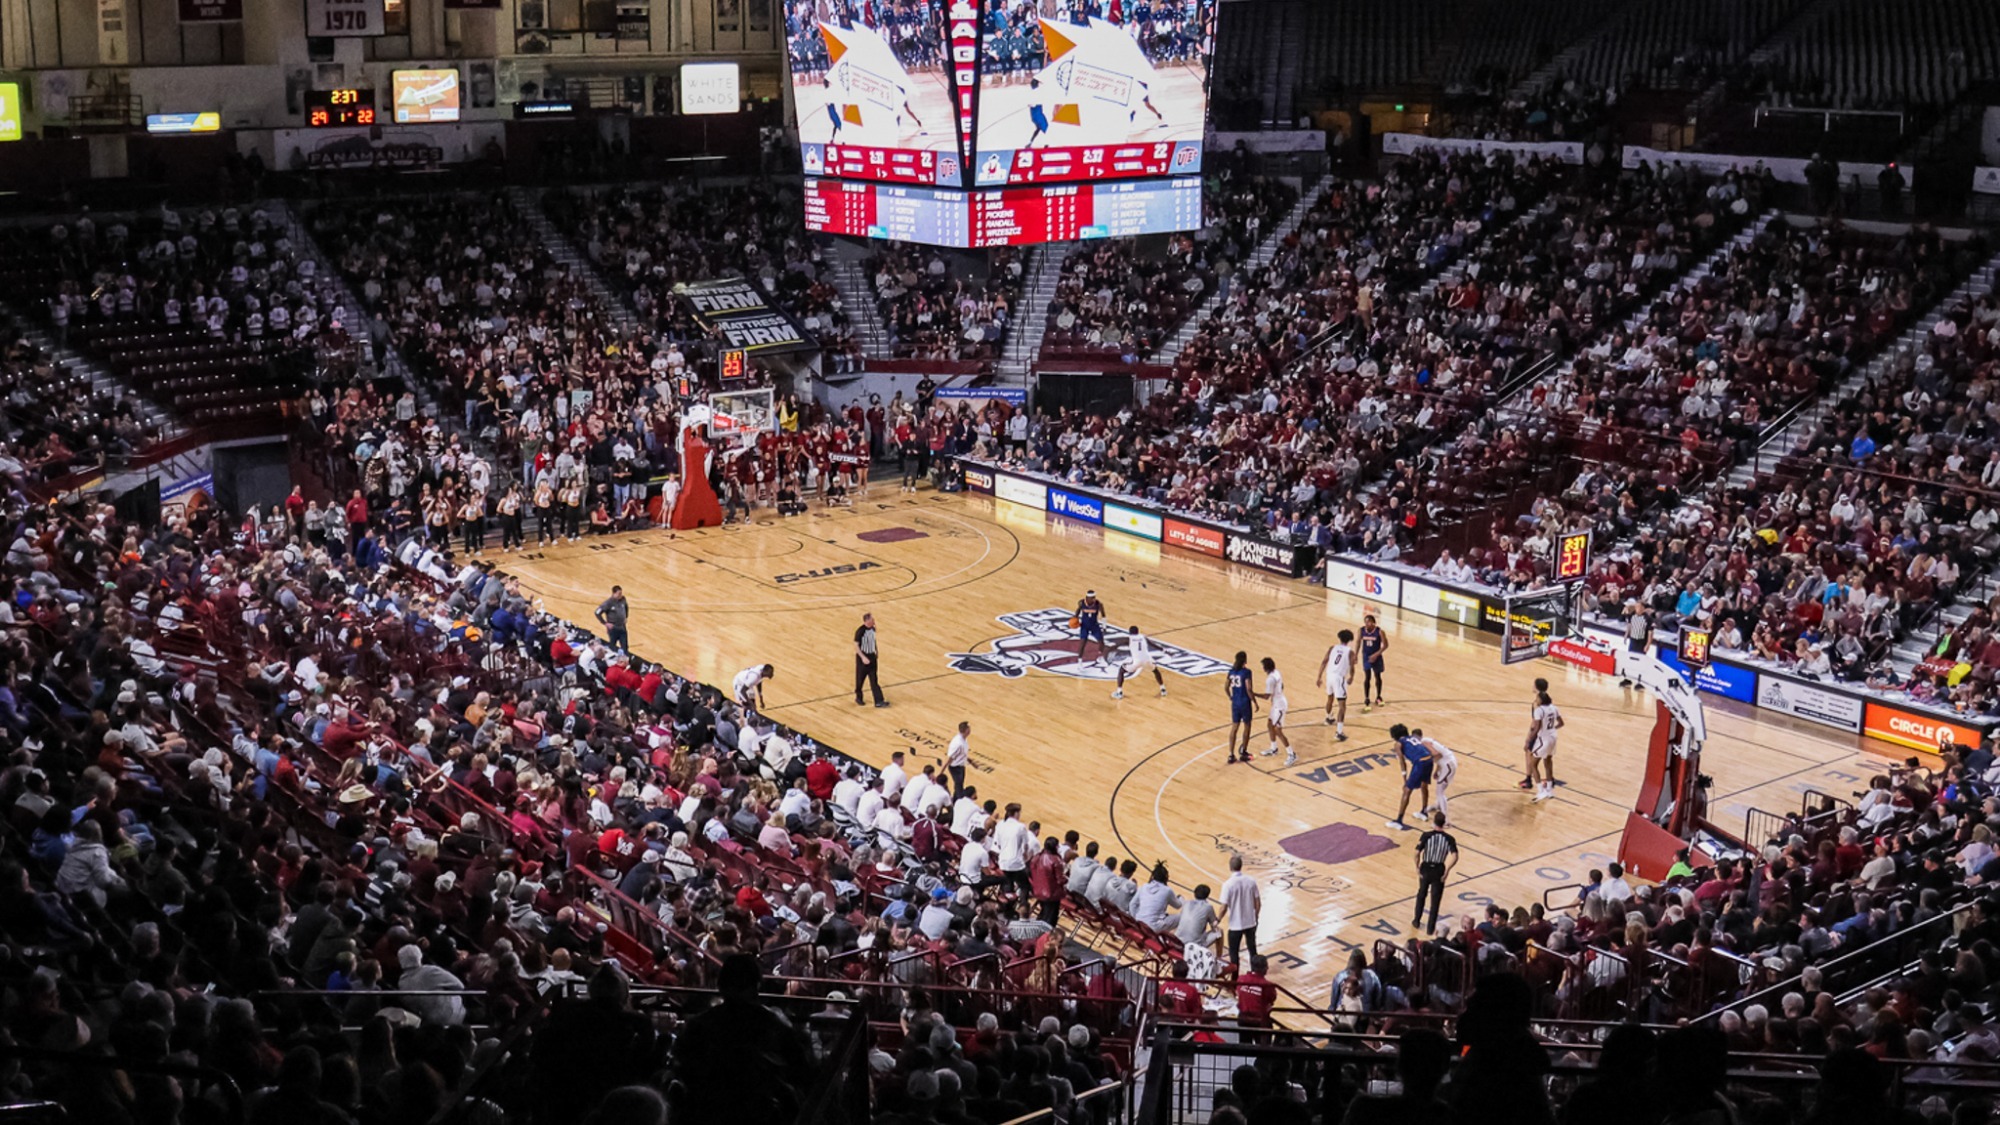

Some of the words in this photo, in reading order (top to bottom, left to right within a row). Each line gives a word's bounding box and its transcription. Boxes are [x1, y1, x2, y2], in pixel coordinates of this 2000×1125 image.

[325, 11, 366, 30] 1970
[687, 77, 733, 90] WHITE
[331, 90, 358, 104] 2:37
[688, 93, 734, 106] SANDS
[311, 111, 328, 125] 29
[357, 109, 374, 123] 22
[685, 283, 752, 297] MATTRESS
[691, 291, 764, 312] FIRM
[718, 316, 787, 331] MATTRESS
[724, 324, 800, 347] FIRM
[723, 361, 739, 376] 23
[1067, 499, 1101, 519] WestStar
[1169, 529, 1185, 540] LET'S
[1185, 534, 1195, 543] GO
[1195, 537, 1220, 550] AGGIES!
[1564, 535, 1585, 552] 2:37
[1240, 540, 1278, 561] PIONEER
[1240, 551, 1266, 567] BANK
[774, 561, 882, 583] C-USA
[1561, 551, 1581, 576] 23
[1364, 572, 1383, 595] DS
[1334, 654, 1343, 665] 0
[1686, 644, 1704, 659] 23
[1229, 675, 1241, 687] 33
[1889, 717, 1935, 740] CIRCLE
[895, 728, 944, 750] SANDS
[1217, 832, 1259, 851] COURT
[1262, 849, 1316, 876] HENSON
[1322, 874, 1352, 890] LOU
